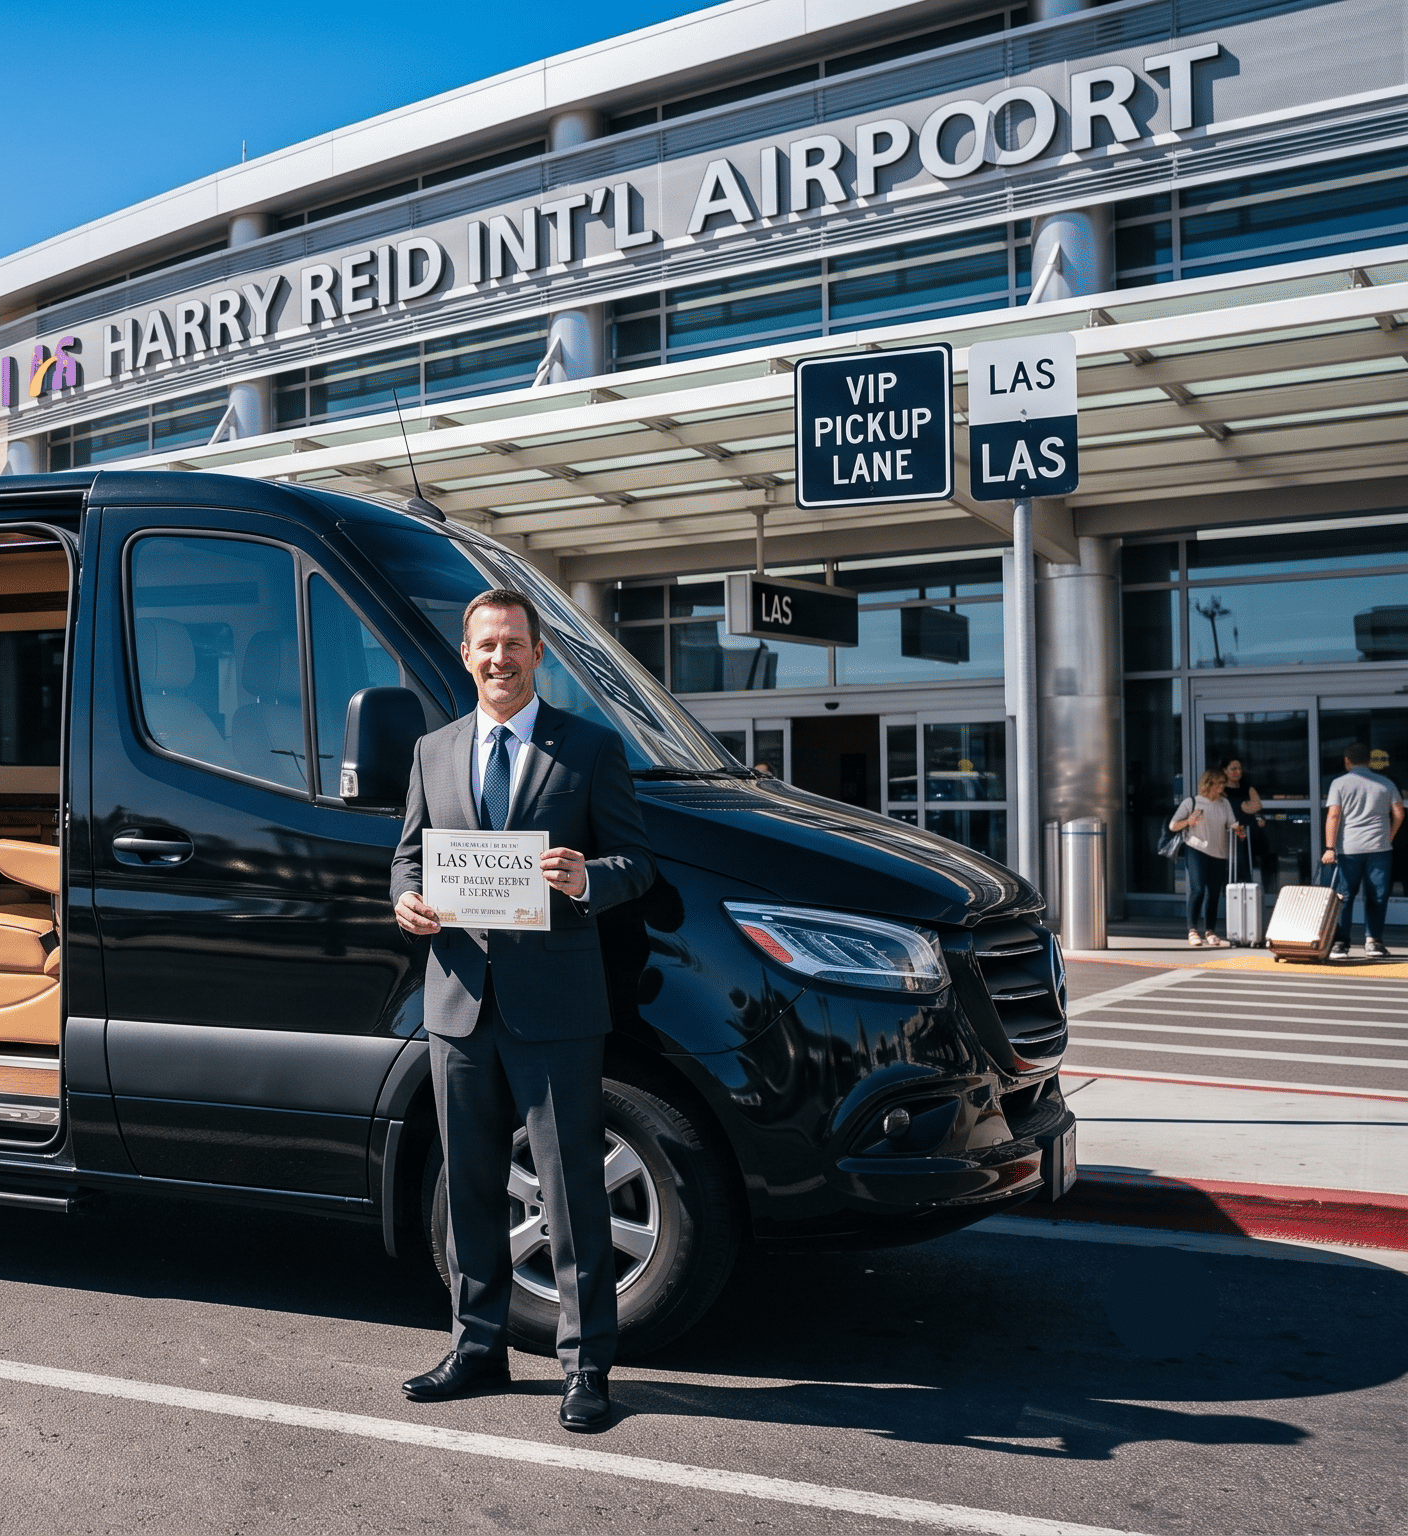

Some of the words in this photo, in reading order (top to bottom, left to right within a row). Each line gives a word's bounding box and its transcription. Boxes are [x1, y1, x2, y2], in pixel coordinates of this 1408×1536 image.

[103, 275, 284, 377] HARRY
[301, 236, 446, 326] REID
[468, 182, 658, 284] INT'L
[687, 42, 1221, 234] AIRPOORT
[846, 372, 897, 405] VIP
[989, 358, 1056, 395] LAS
[815, 407, 932, 447] PICKUP
[833, 449, 913, 485] LANE
[981, 436, 1067, 484] LAS
[761, 592, 792, 625] LAS
[437, 853, 467, 868] LAS
